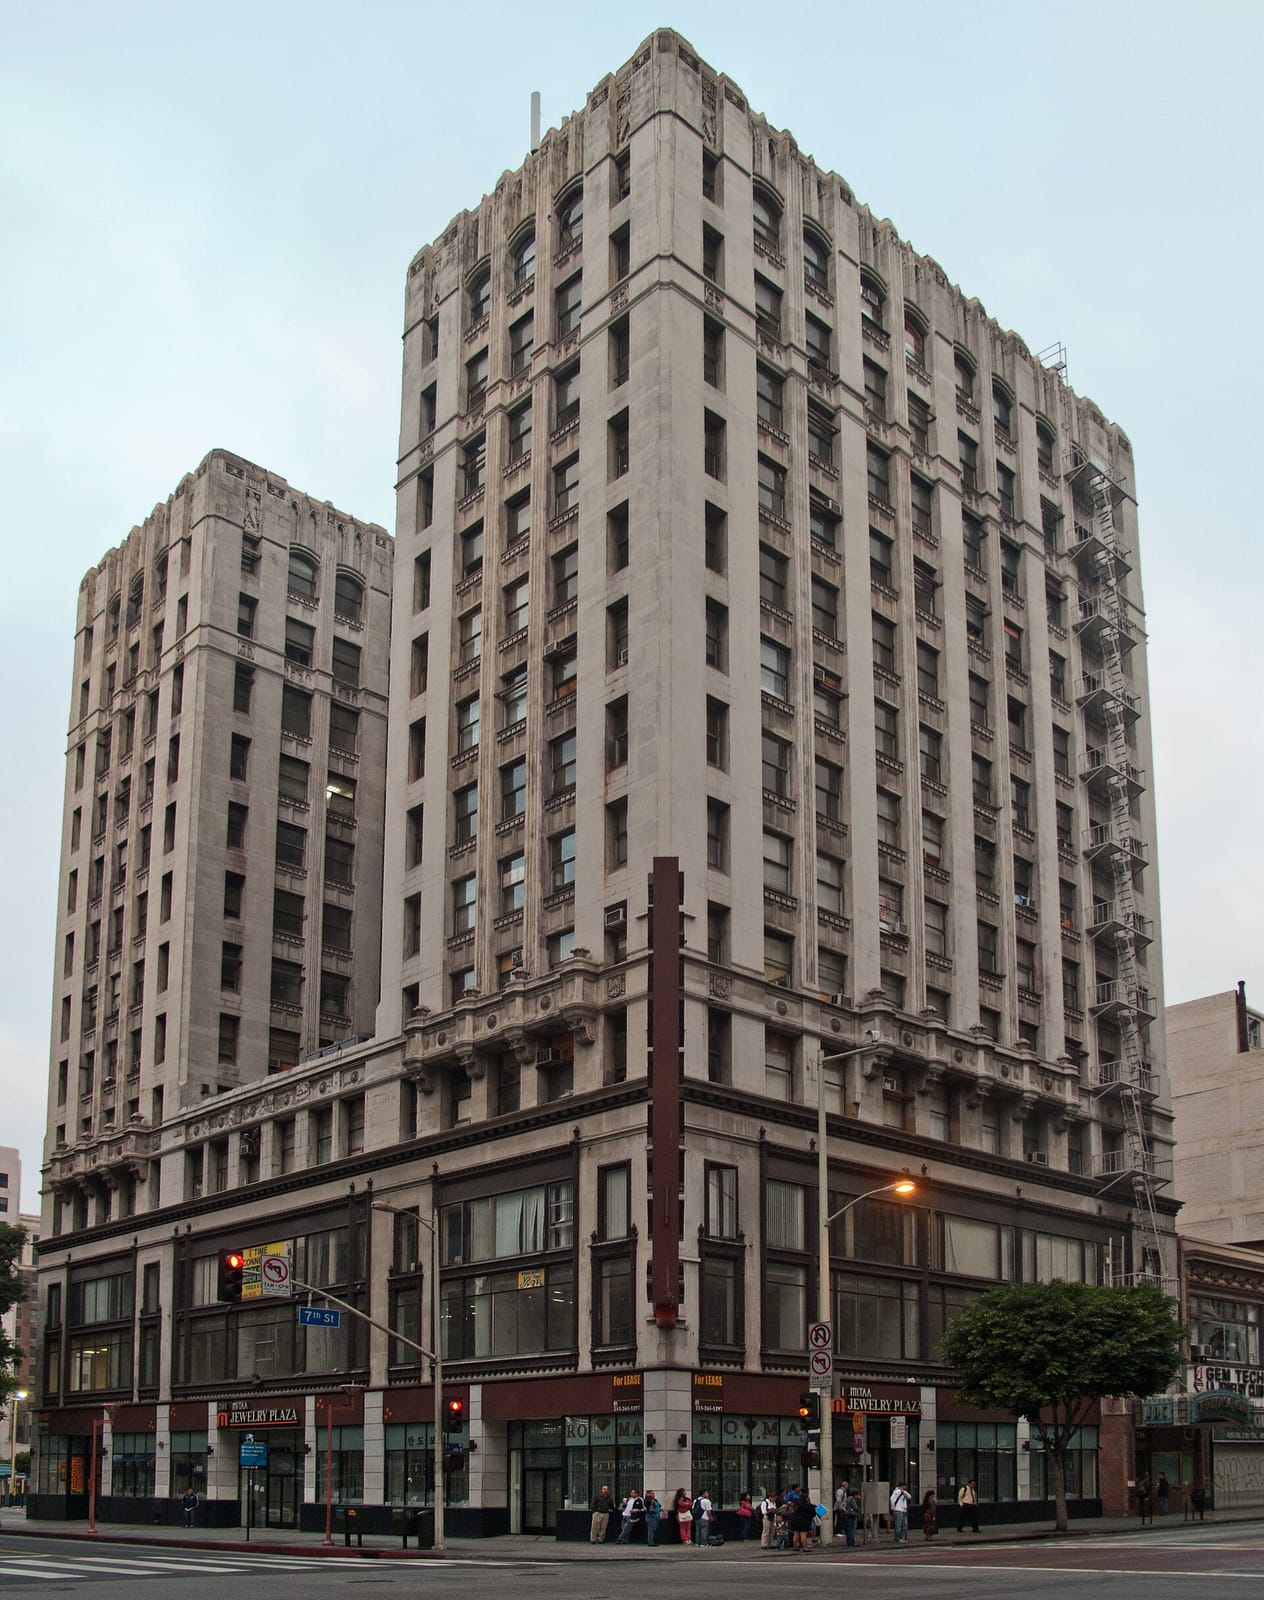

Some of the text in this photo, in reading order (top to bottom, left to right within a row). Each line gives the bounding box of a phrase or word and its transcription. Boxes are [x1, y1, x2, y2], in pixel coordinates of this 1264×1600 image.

[305, 1311, 334, 1323] 7th St
[613, 1374, 640, 1386] For LEASE
[694, 1375, 723, 1386] For LEASE
[1206, 1366, 1264, 1383] GEM TECH
[847, 1398, 894, 1411] JEWELRY
[230, 1408, 297, 1423] JEWELRY PLAZA
